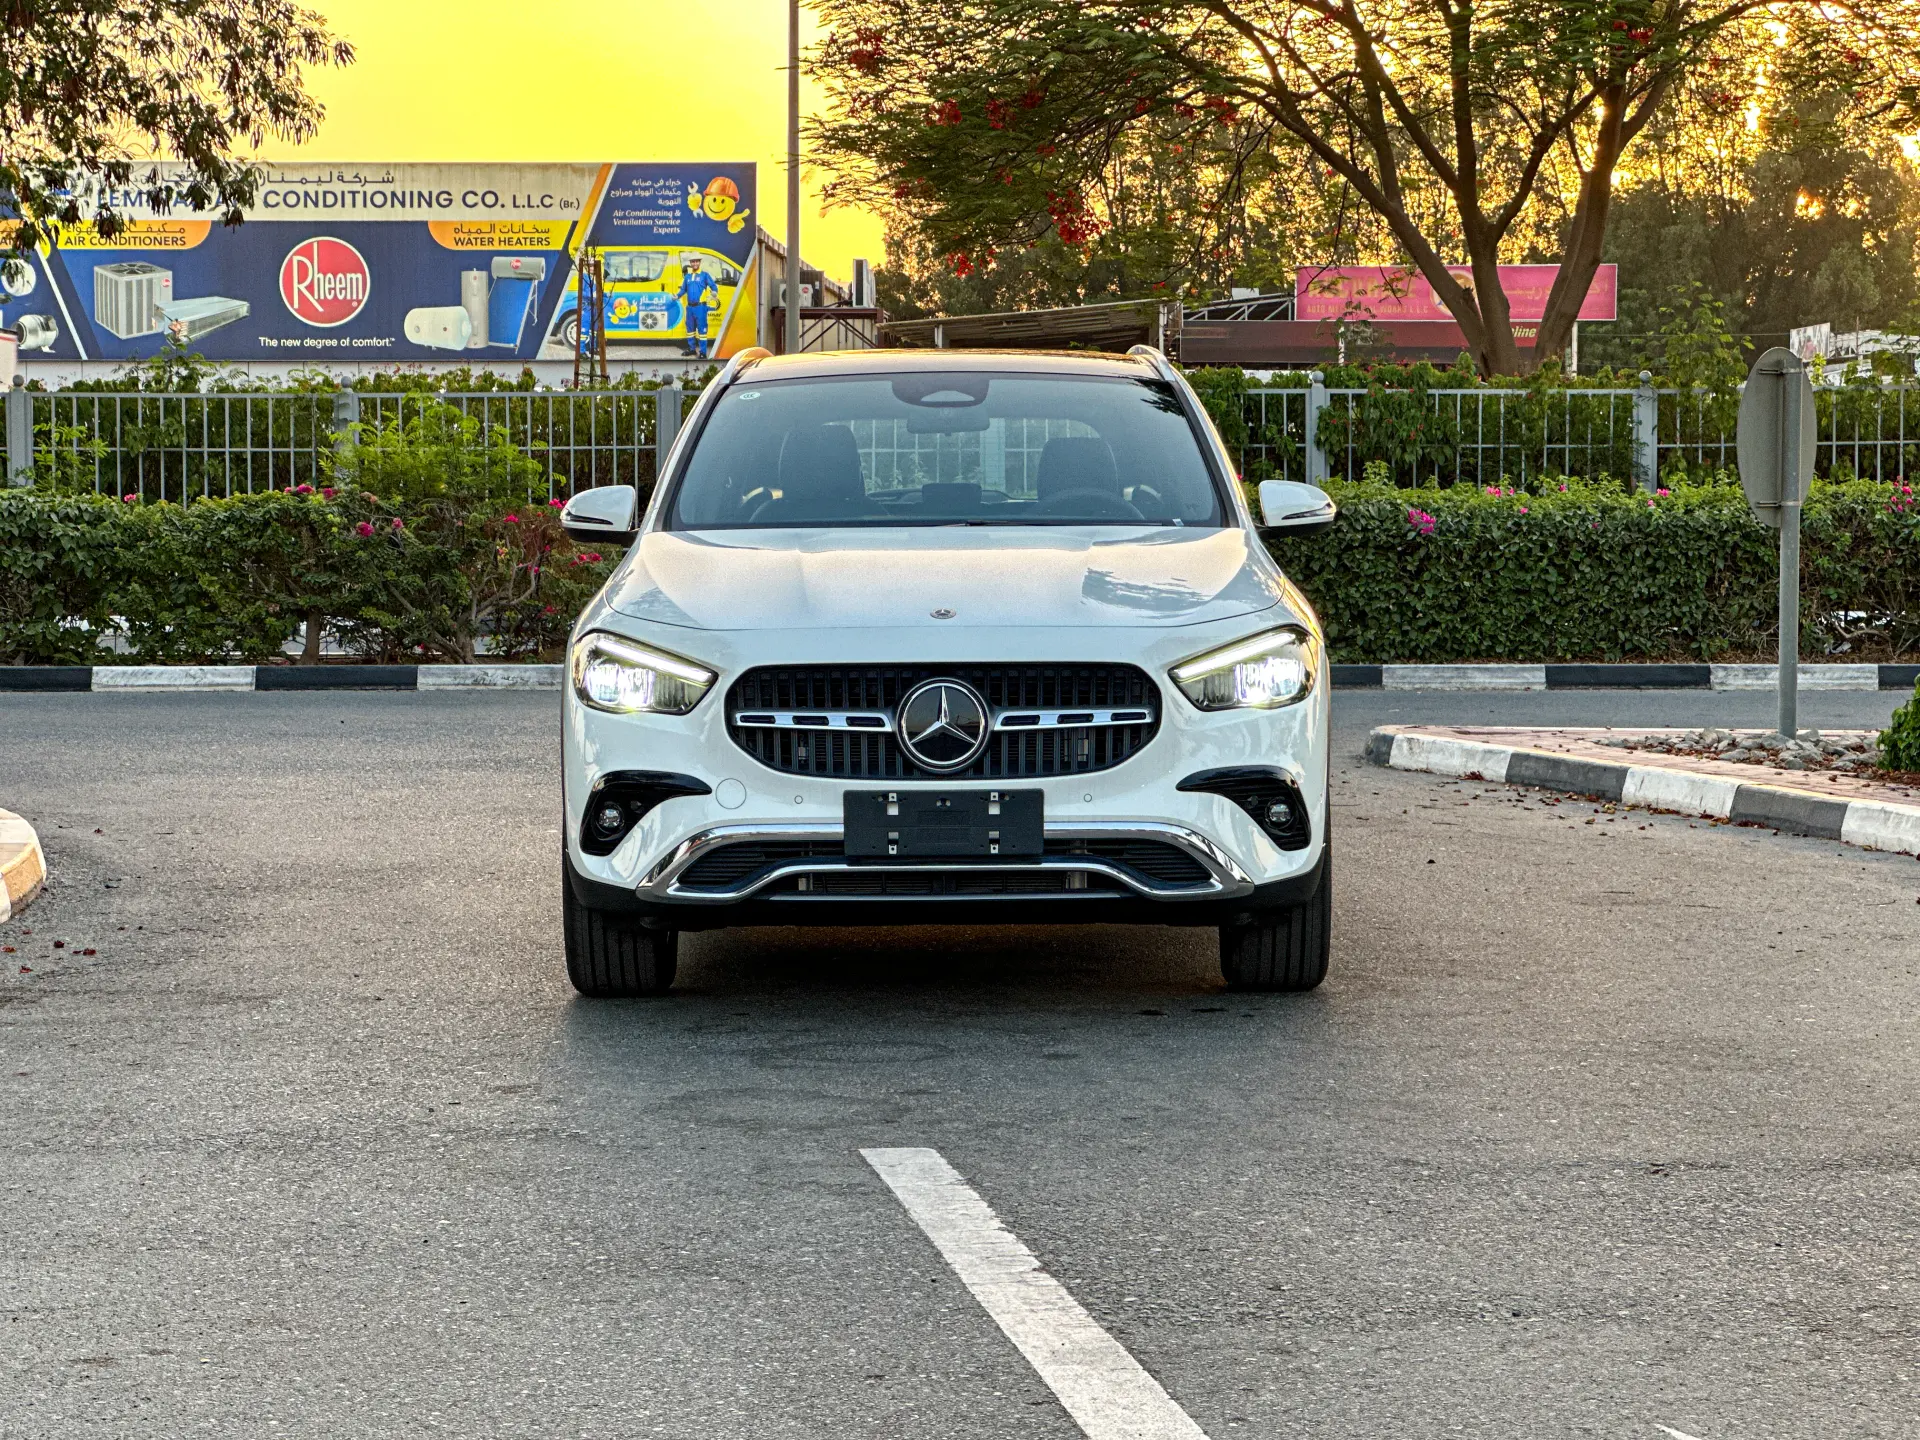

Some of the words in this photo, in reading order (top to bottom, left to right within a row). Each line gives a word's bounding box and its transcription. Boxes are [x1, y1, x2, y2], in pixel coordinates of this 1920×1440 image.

[337, 170, 394, 187] شركة
[263, 190, 453, 209] CONDITIONING
[462, 190, 505, 209] CO.
[512, 194, 554, 209] L.L.C
[559, 198, 580, 211] (Br.)
[625, 209, 673, 218] Conditioning
[613, 218, 652, 226] Ventilation
[654, 218, 681, 226] Service
[454, 223, 495, 236] المياه
[500, 223, 550, 234] سخانات
[653, 226, 681, 235] Experts
[64, 236, 85, 246] AIR
[90, 236, 186, 246] CONDITIONERS
[454, 237, 494, 246] WATER
[498, 237, 550, 246] HEATERS
[292, 241, 362, 312] Rheem
[259, 336, 278, 347] The
[281, 339, 301, 347] new
[304, 337, 338, 349] degree
[340, 337, 351, 347] of
